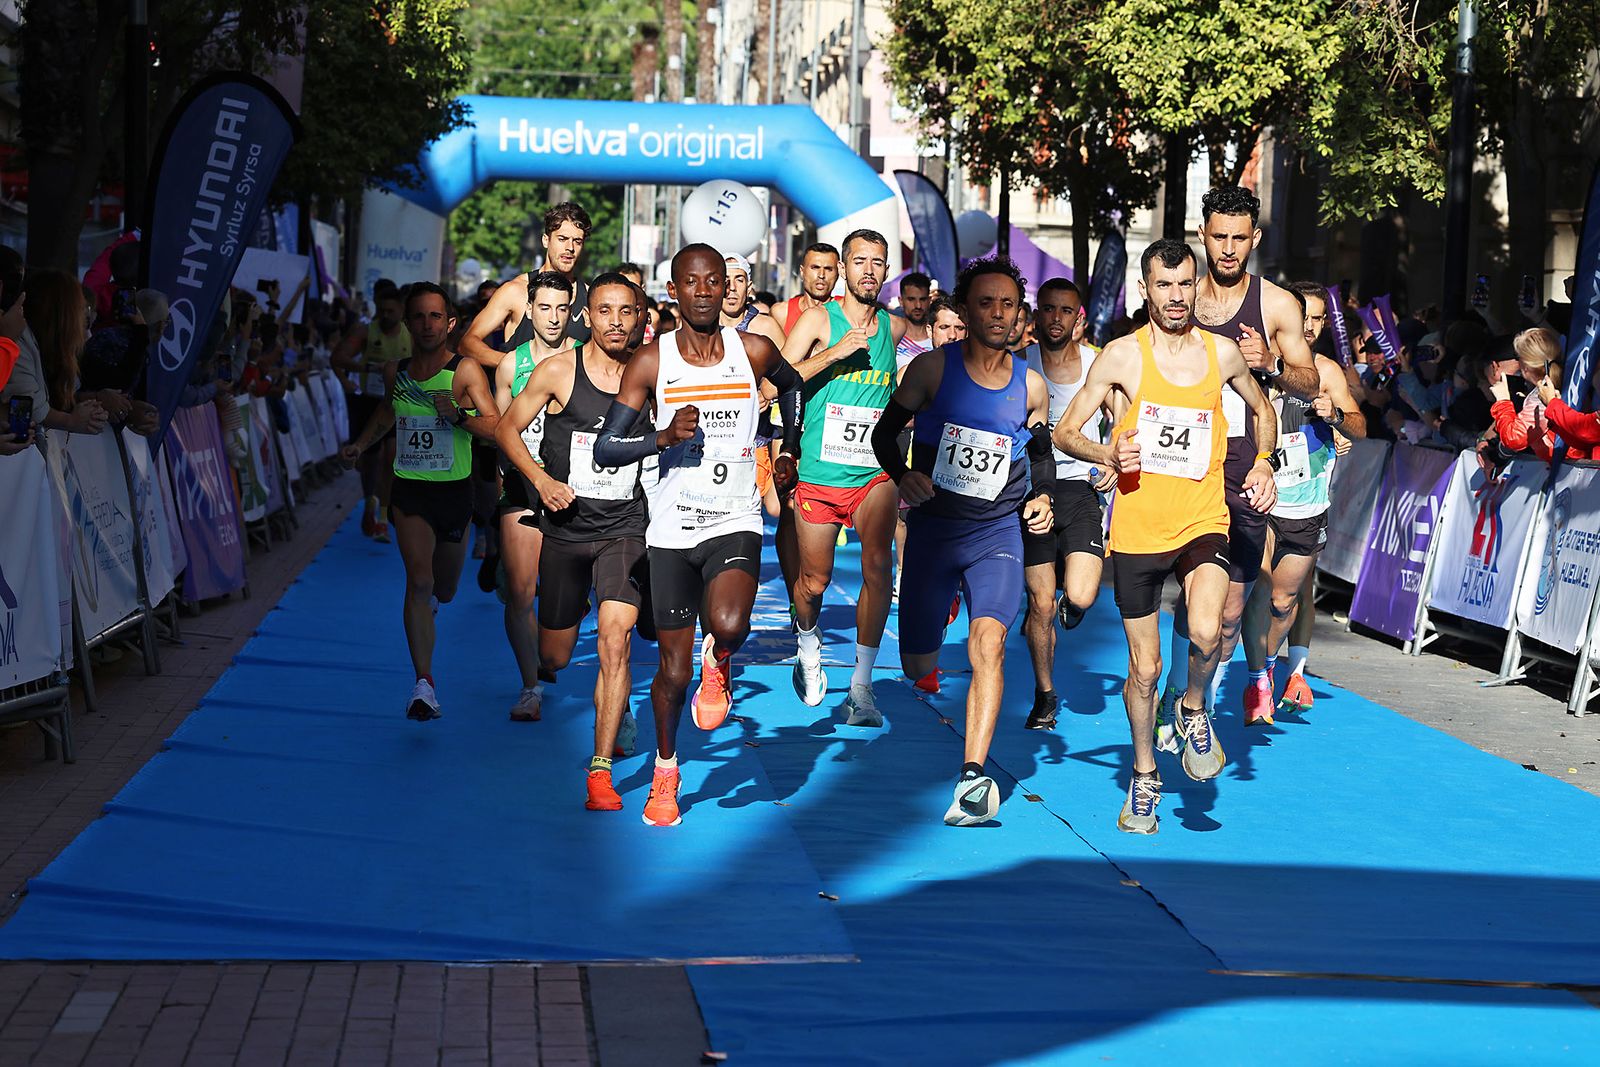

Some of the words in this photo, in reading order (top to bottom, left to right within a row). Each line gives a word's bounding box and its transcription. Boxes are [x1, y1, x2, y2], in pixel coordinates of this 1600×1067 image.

[500, 118, 627, 156] Huelva
[640, 124, 764, 166] original
[177, 97, 249, 288] HYUNDAI
[220, 199, 247, 256] Syrluz
[236, 144, 262, 196] Syrsa
[708, 189, 738, 226] 1:15
[367, 243, 423, 262] Huelva
[703, 410, 741, 420] VICKY
[831, 406, 844, 416] 2K
[1145, 405, 1160, 417] 2K
[399, 416, 408, 426] 2K
[1197, 412, 1209, 423] 2K
[843, 423, 870, 443] 57
[948, 427, 963, 439] 2K
[1158, 425, 1191, 450] 54
[408, 431, 434, 449] 49
[577, 434, 591, 446] 2K
[995, 437, 1008, 449] 2K
[741, 447, 753, 457] 2K
[824, 444, 852, 453] CUESTAS
[824, 450, 852, 460] Huelva
[945, 443, 1005, 475] 1337
[1150, 452, 1189, 463] MARHOUM
[712, 463, 728, 484] 9
[935, 473, 967, 489] Huelva
